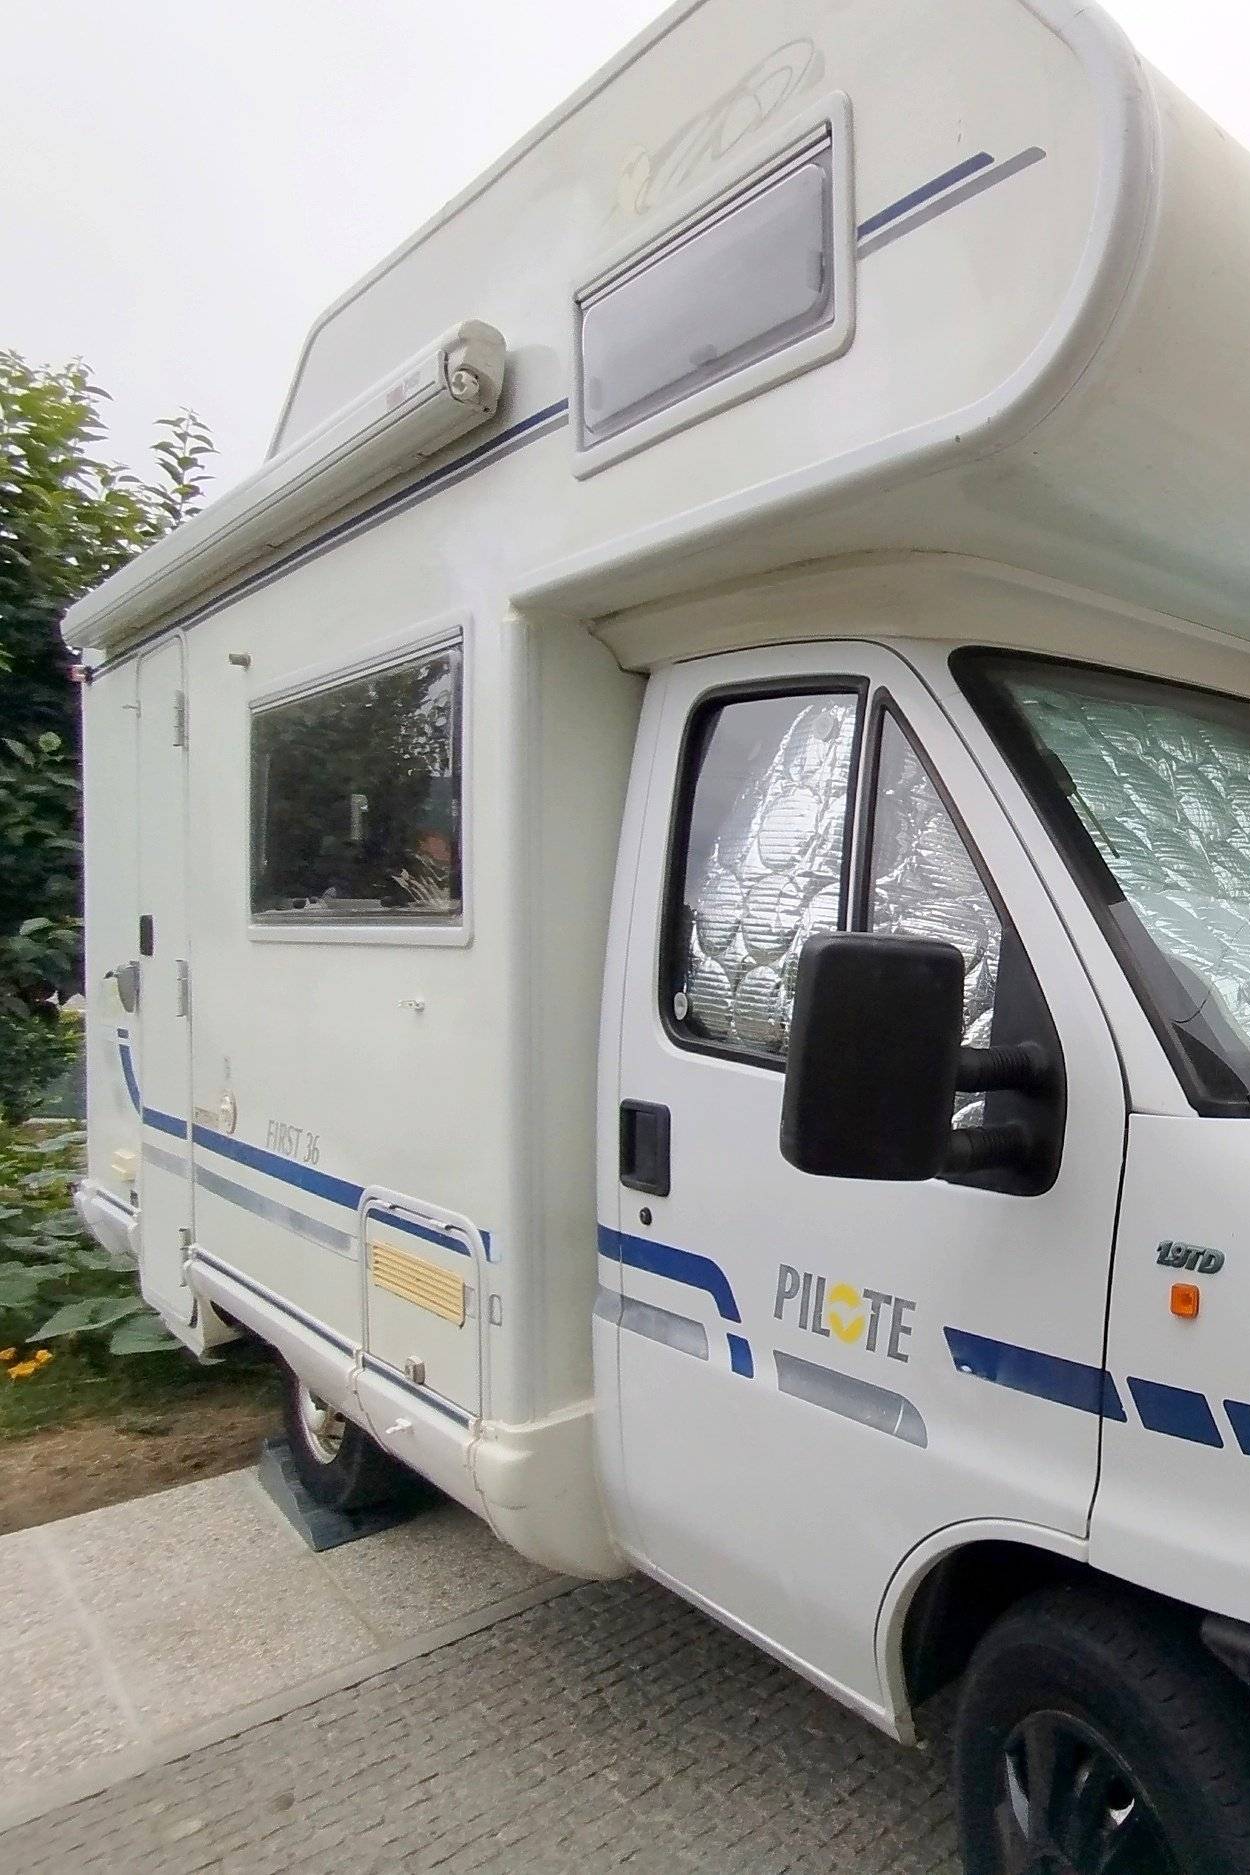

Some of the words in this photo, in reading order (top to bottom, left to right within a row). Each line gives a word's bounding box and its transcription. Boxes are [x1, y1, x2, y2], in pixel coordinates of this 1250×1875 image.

[265, 1119, 303, 1157] FIRST
[303, 1131, 321, 1165] 36
[773, 1263, 917, 1363] PILOTE
